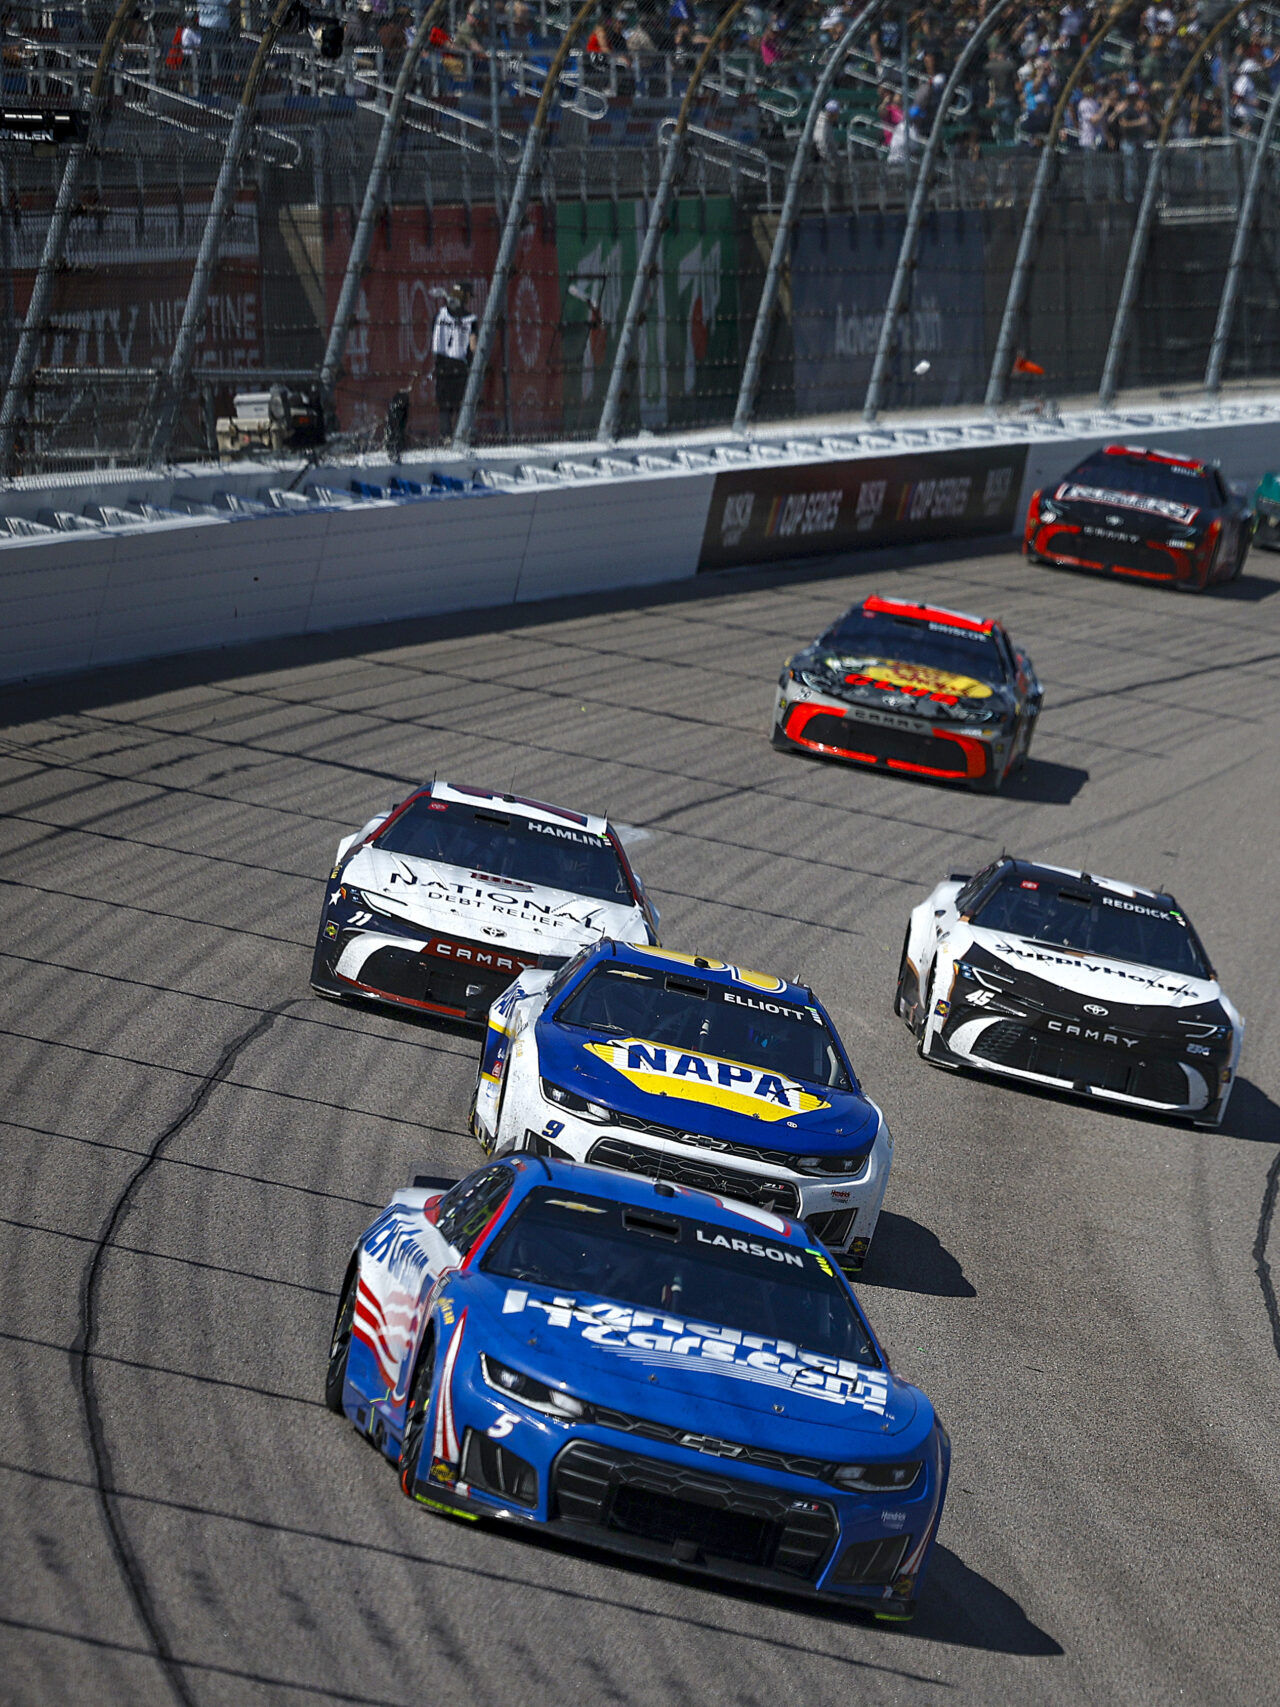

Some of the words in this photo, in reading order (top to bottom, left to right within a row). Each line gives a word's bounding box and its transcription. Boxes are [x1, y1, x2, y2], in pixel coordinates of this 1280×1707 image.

[527, 821, 602, 848] HAMLIN
[347, 911, 373, 927] 11
[428, 891, 486, 908] DEBT
[493, 905, 565, 928] RELIEF
[1102, 896, 1171, 921] REDDICK
[723, 992, 804, 1021] ELLIOTT
[965, 989, 995, 1006] 45
[1048, 1021, 1139, 1048] CAMRY
[627, 1043, 793, 1107] NAPA
[542, 1119, 566, 1138] 9
[696, 1230, 804, 1268] LARSON
[487, 1412, 522, 1438] 5
